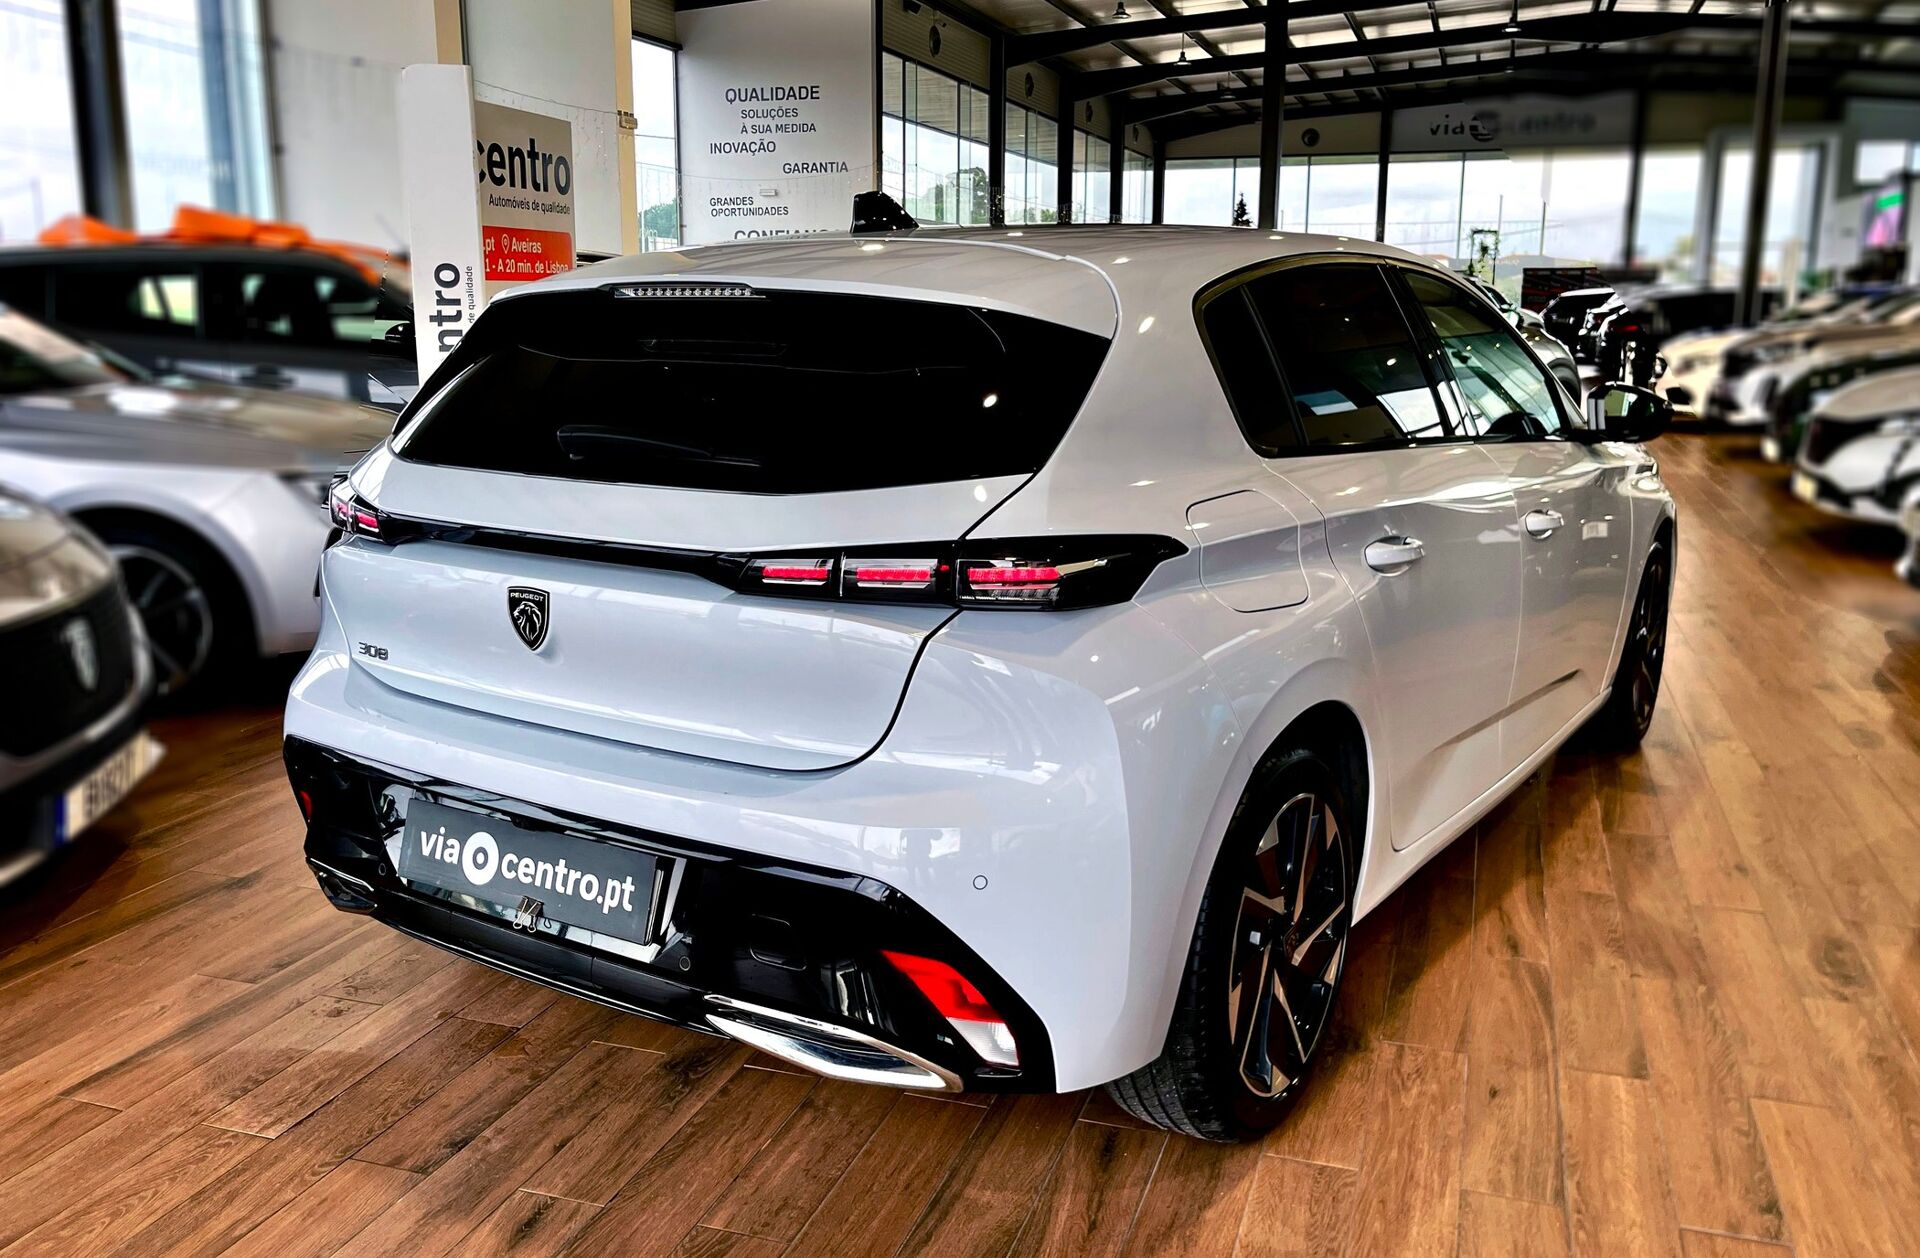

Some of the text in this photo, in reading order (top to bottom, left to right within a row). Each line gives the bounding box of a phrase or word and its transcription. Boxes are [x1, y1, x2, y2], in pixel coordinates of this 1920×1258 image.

[725, 85, 820, 104] QUALIDADE
[741, 106, 798, 120] SOLUÇÕES
[740, 122, 817, 134] À SUA MEDIDA
[710, 138, 776, 156] INOVAÇÃO
[782, 161, 849, 174] GARANTIA
[488, 193, 571, 215] Automóveis de qualidade
[710, 196, 754, 206] GRANDES
[710, 206, 789, 217] OPORTUNIDADES
[511, 237, 542, 254] Aveiras
[497, 258, 504, 273] A
[505, 258, 516, 273] 20
[517, 259, 534, 273] min.
[535, 260, 544, 273] de
[465, 265, 476, 311] qualidade
[510, 592, 544, 602] PEUGEOT
[359, 641, 389, 661] 308
[420, 826, 636, 914] via centro.pt
